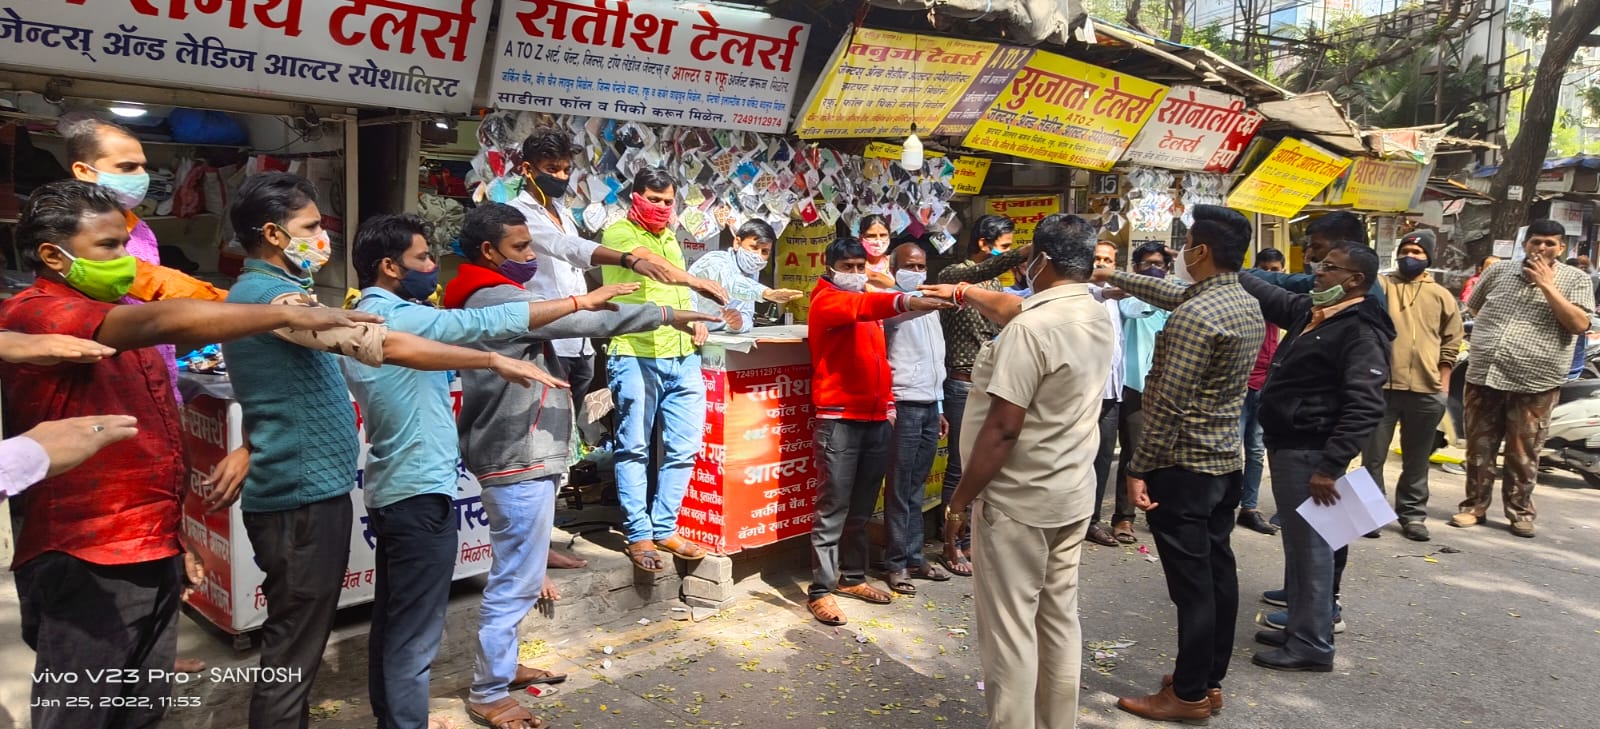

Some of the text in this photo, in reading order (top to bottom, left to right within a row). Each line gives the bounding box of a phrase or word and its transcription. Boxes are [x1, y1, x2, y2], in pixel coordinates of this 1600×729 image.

[515, 0, 804, 73] सतीश टेलर्स
[175, 32, 257, 72] लेडिज
[264, 54, 342, 83] आल्टर
[348, 58, 460, 98] स्पेशालिस्ट
[503, 40, 513, 57] A
[517, 41, 533, 59] TO
[534, 44, 544, 60] Z
[672, 66, 702, 84] आल्टर
[704, 70, 713, 84] व
[715, 71, 729, 92] रफू
[1006, 65, 1164, 124] सुजाता टेलर्स
[497, 91, 783, 128] साडीला फॉल व पिको करून मिळेल. 7249112974
[1065, 112, 1095, 127] A TO Z
[1157, 90, 1245, 134] सोनाली
[1158, 129, 1206, 153] टेलर्स
[991, 198, 1054, 212] सुजाता
[785, 252, 800, 267] A
[736, 367, 782, 379] 7249112974
[745, 374, 811, 402] सतीश
[800, 404, 810, 413] व
[743, 456, 810, 485] आल्टर
[675, 523, 727, 547] 249112974
[365, 568, 375, 585] व
